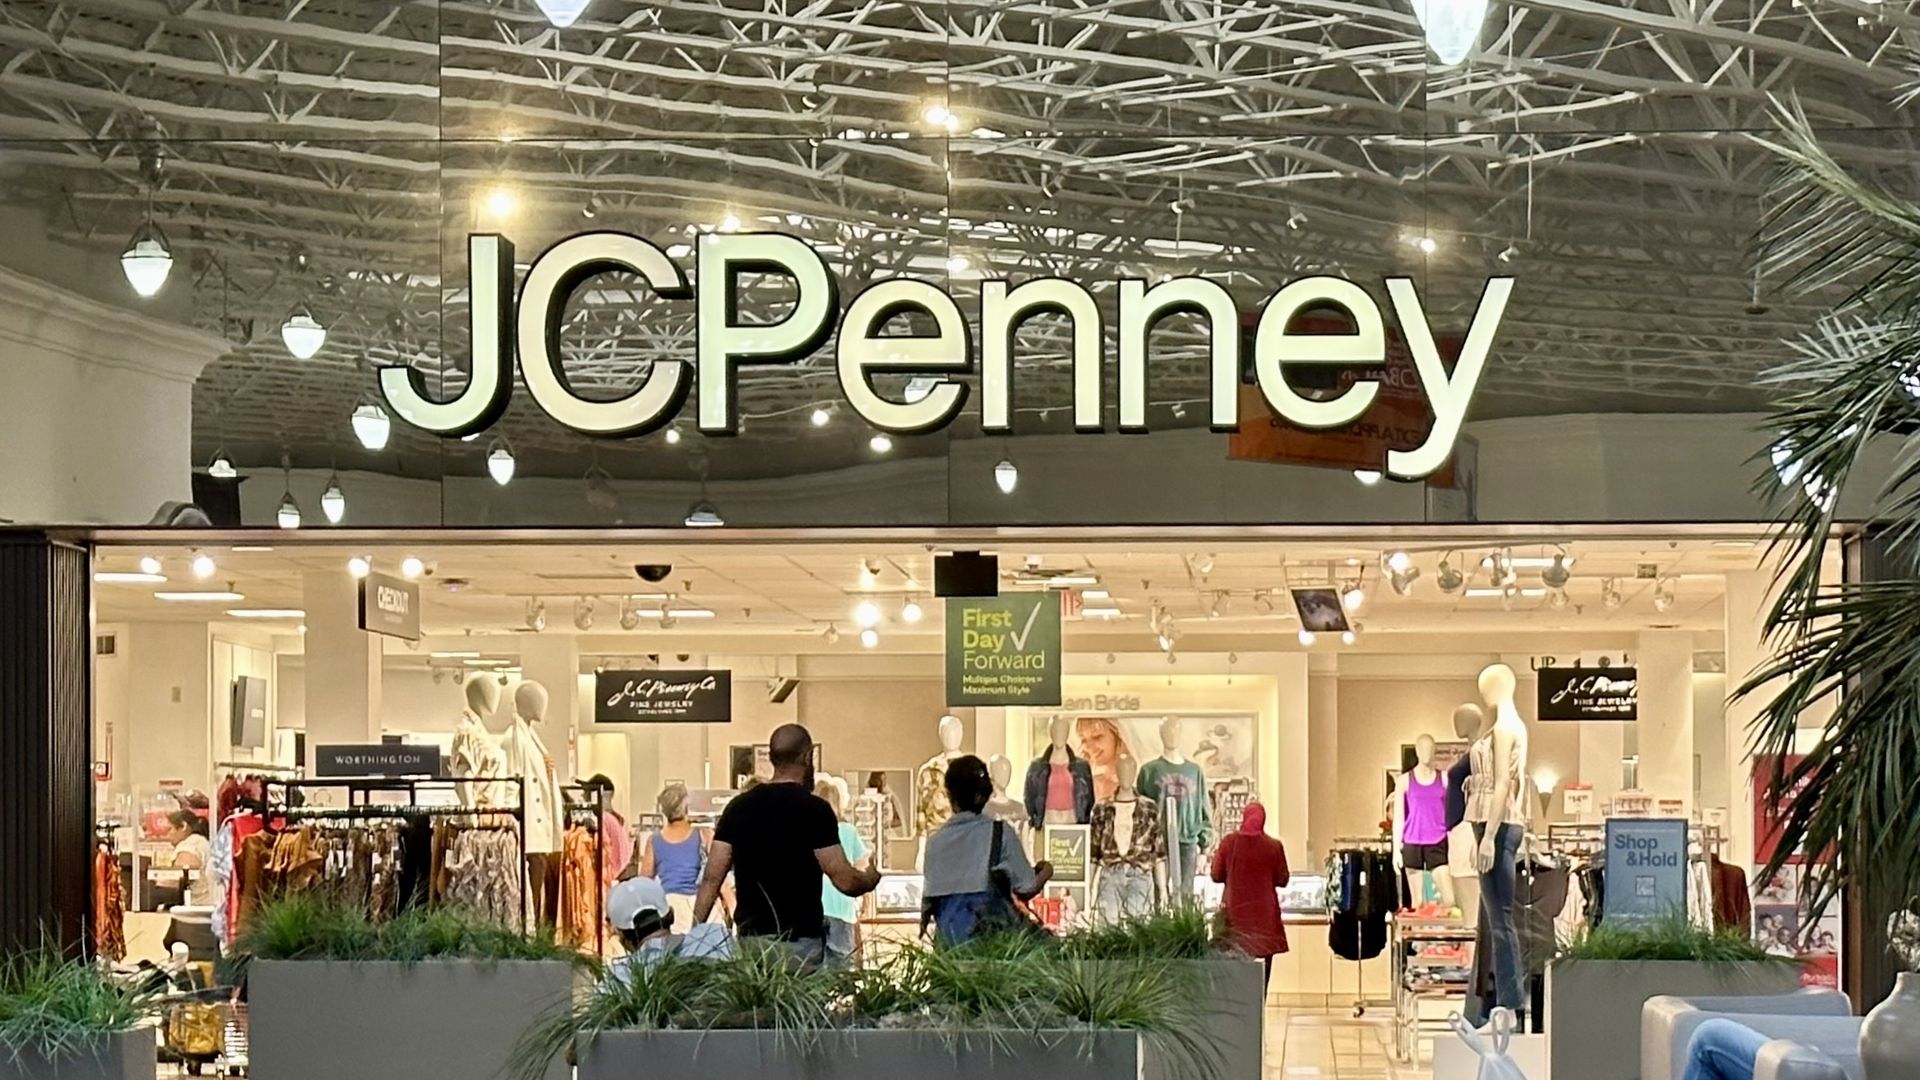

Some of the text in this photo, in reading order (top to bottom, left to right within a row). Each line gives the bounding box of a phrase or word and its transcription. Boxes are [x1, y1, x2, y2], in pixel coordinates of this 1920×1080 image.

[378, 230, 1516, 480] JCPenney
[962, 607, 1012, 627] First
[962, 630, 1006, 652] Day
[963, 650, 1045, 670] Forward
[962, 675, 998, 685] Multiple
[962, 685, 1030, 696] Maximum Style
[1095, 694, 1140, 711] Bride
[335, 755, 421, 765] WORTHINGTON
[1614, 834, 1658, 856] Shop
[1626, 851, 1678, 867] &Hold
